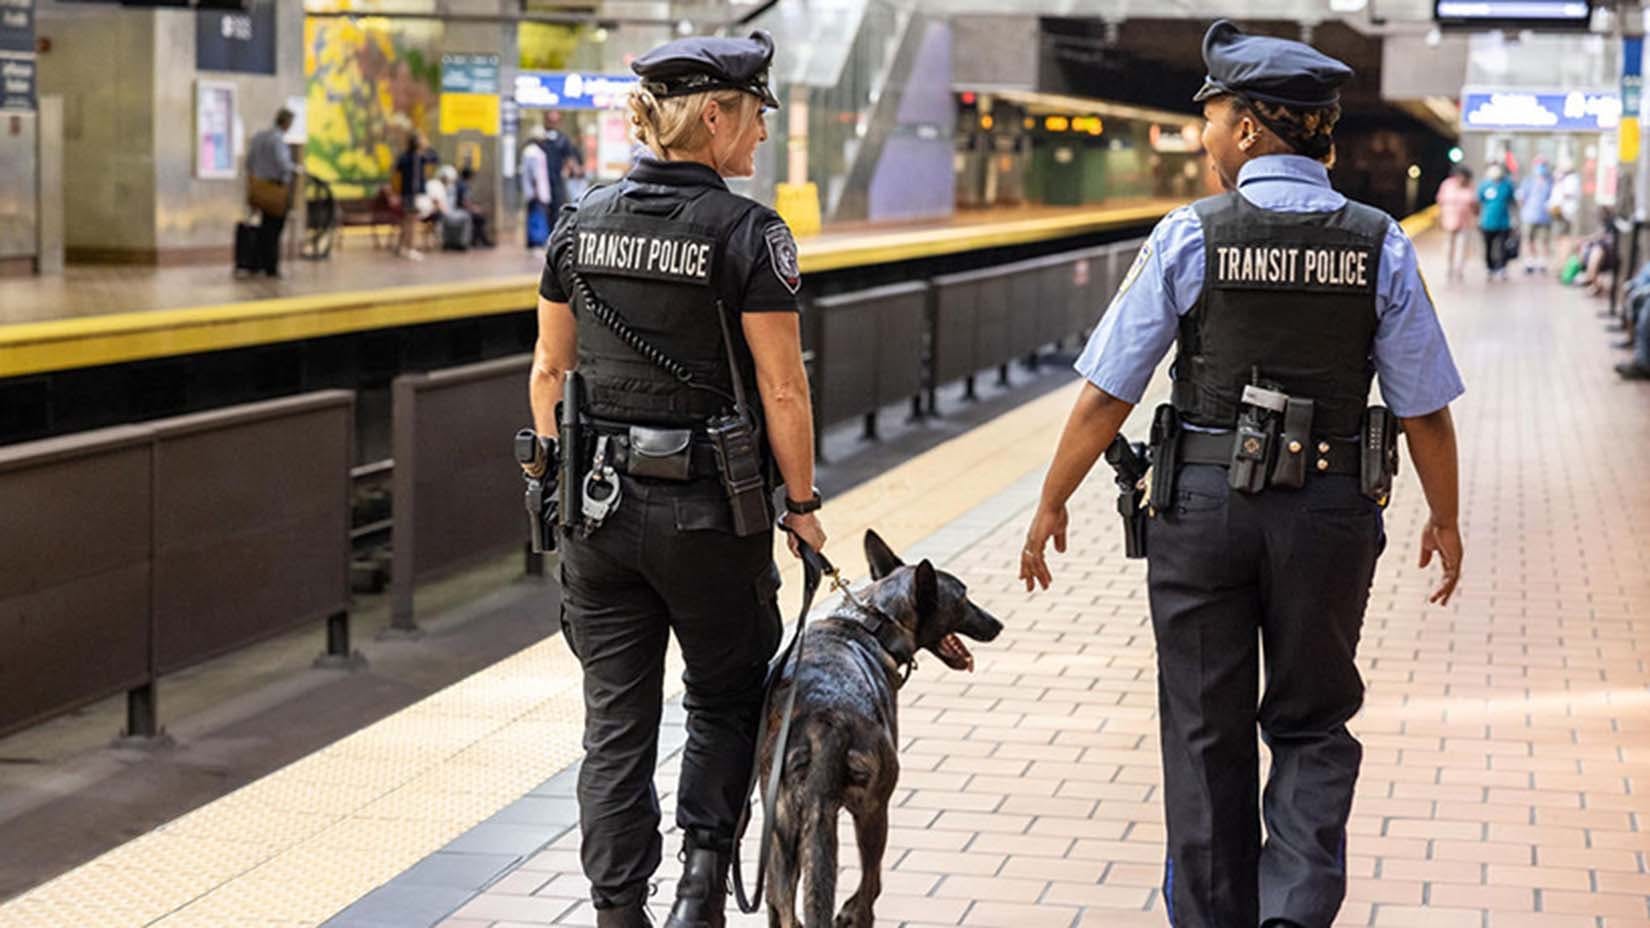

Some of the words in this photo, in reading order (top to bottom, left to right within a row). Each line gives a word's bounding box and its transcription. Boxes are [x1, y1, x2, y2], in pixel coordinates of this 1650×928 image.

[578, 233, 646, 268] TRANSIT
[647, 239, 709, 276] POLICE
[1217, 247, 1298, 282] TRANSIT
[1304, 249, 1368, 285] POLICE
